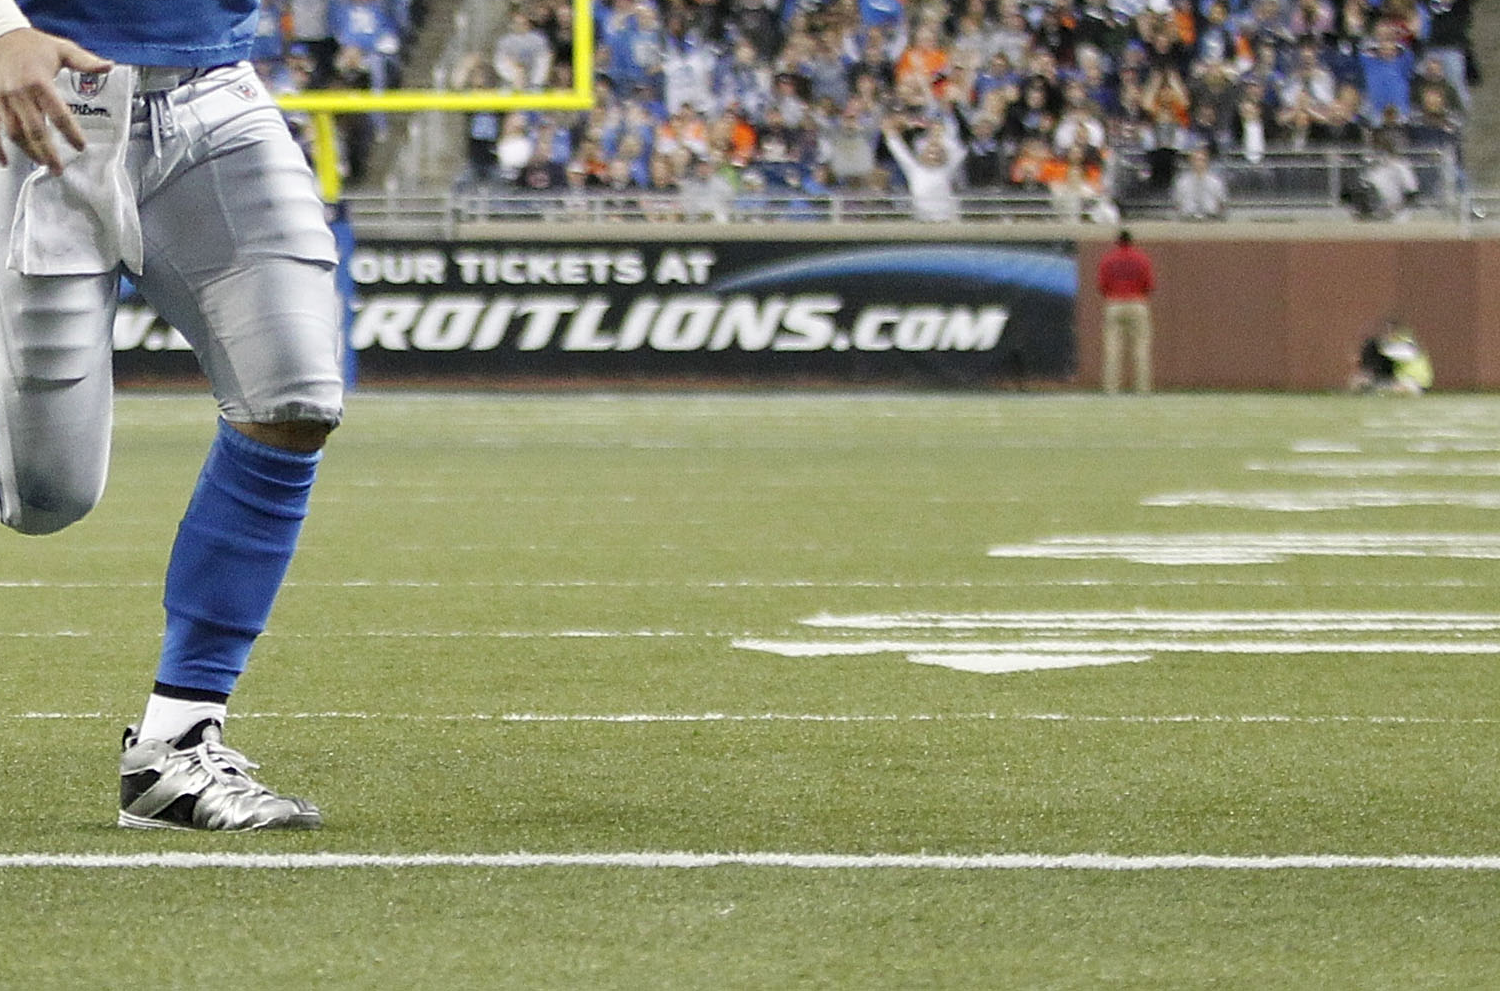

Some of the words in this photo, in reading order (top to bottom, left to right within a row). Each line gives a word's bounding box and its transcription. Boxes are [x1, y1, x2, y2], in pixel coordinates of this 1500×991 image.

[457, 249, 645, 284] TICKETS
[655, 249, 714, 284] AT
[352, 294, 1008, 351] ROITLIONS.COM
